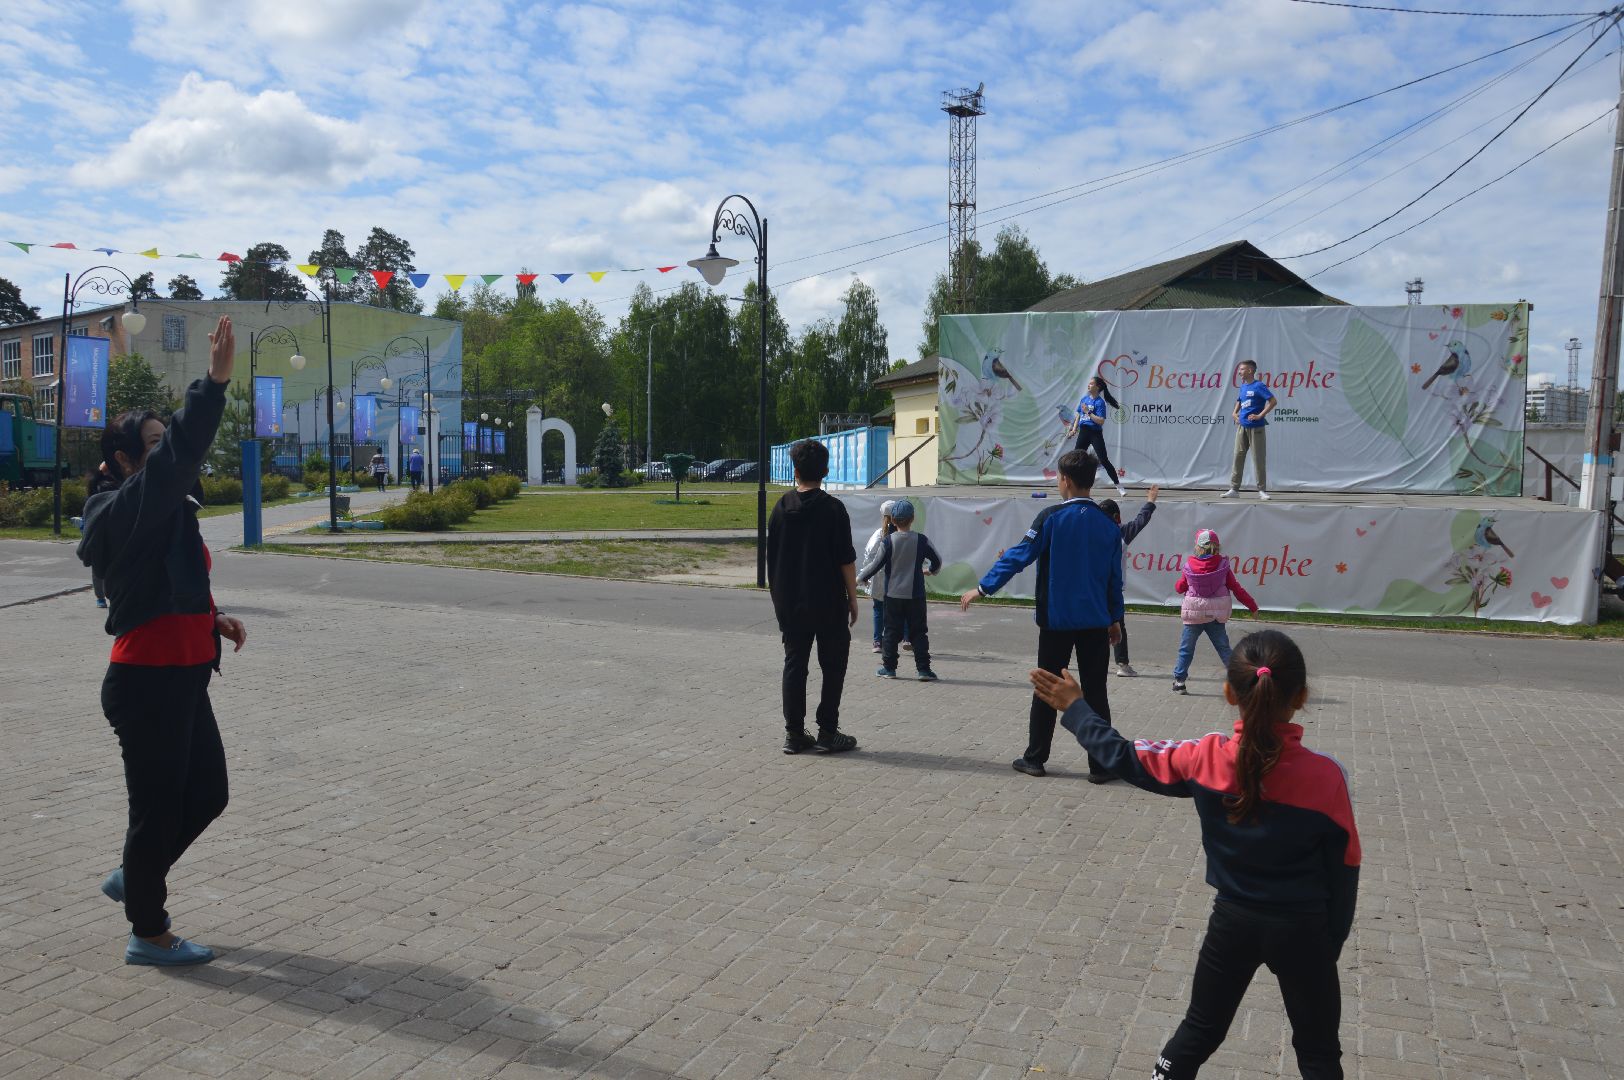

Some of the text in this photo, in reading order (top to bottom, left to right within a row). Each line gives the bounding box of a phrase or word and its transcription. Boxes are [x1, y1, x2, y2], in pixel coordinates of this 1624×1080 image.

[1145, 364, 1223, 389] Весна
[1133, 404, 1172, 413] ПАРКИ
[1274, 408, 1299, 416] ПАРК
[1133, 415, 1225, 425] ПОДМОСКОВЬЯ
